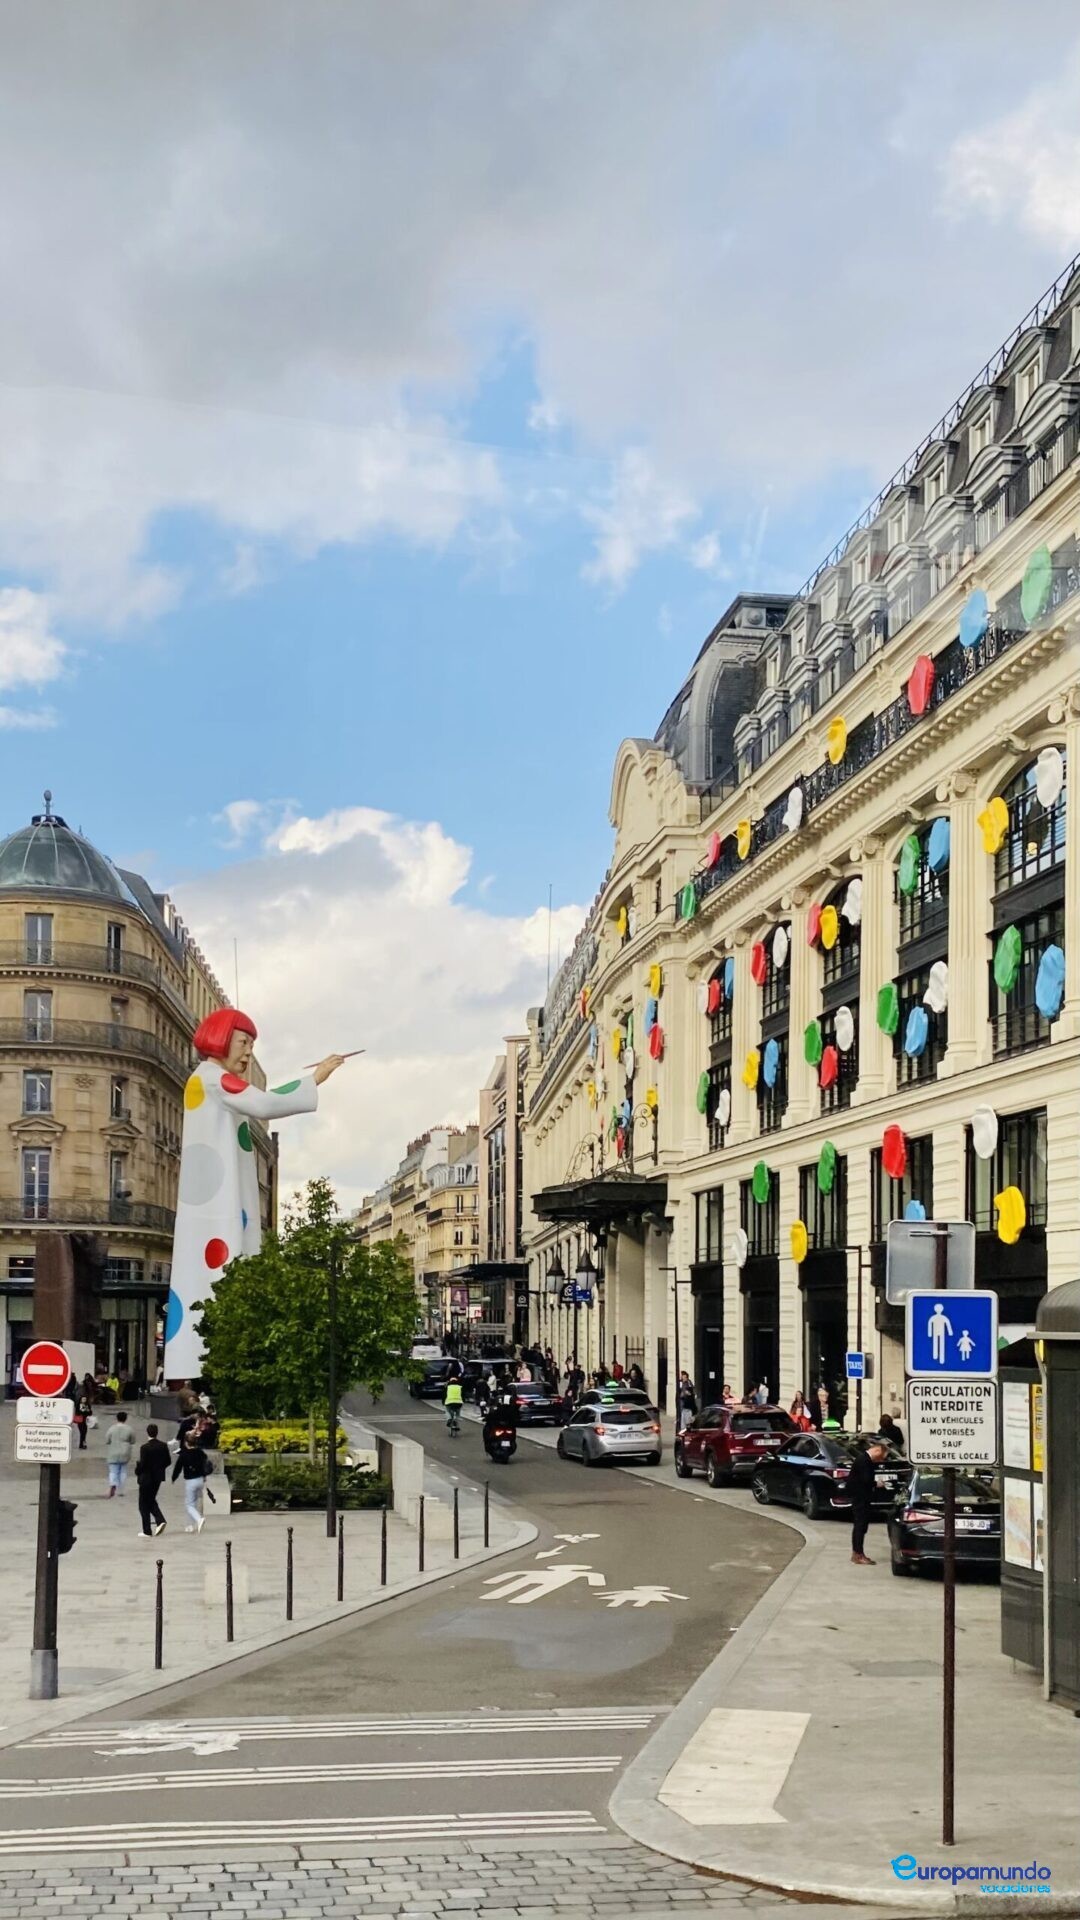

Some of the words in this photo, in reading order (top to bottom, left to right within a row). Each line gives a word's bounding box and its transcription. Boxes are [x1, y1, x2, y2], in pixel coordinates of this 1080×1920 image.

[912, 1386, 992, 1397] CIRCULATION
[920, 1401, 984, 1412] INTERDITE
[941, 1416, 984, 1425] VÉHICULES
[942, 1440, 963, 1448] SAUF
[916, 1452, 956, 1460] DESSERTE
